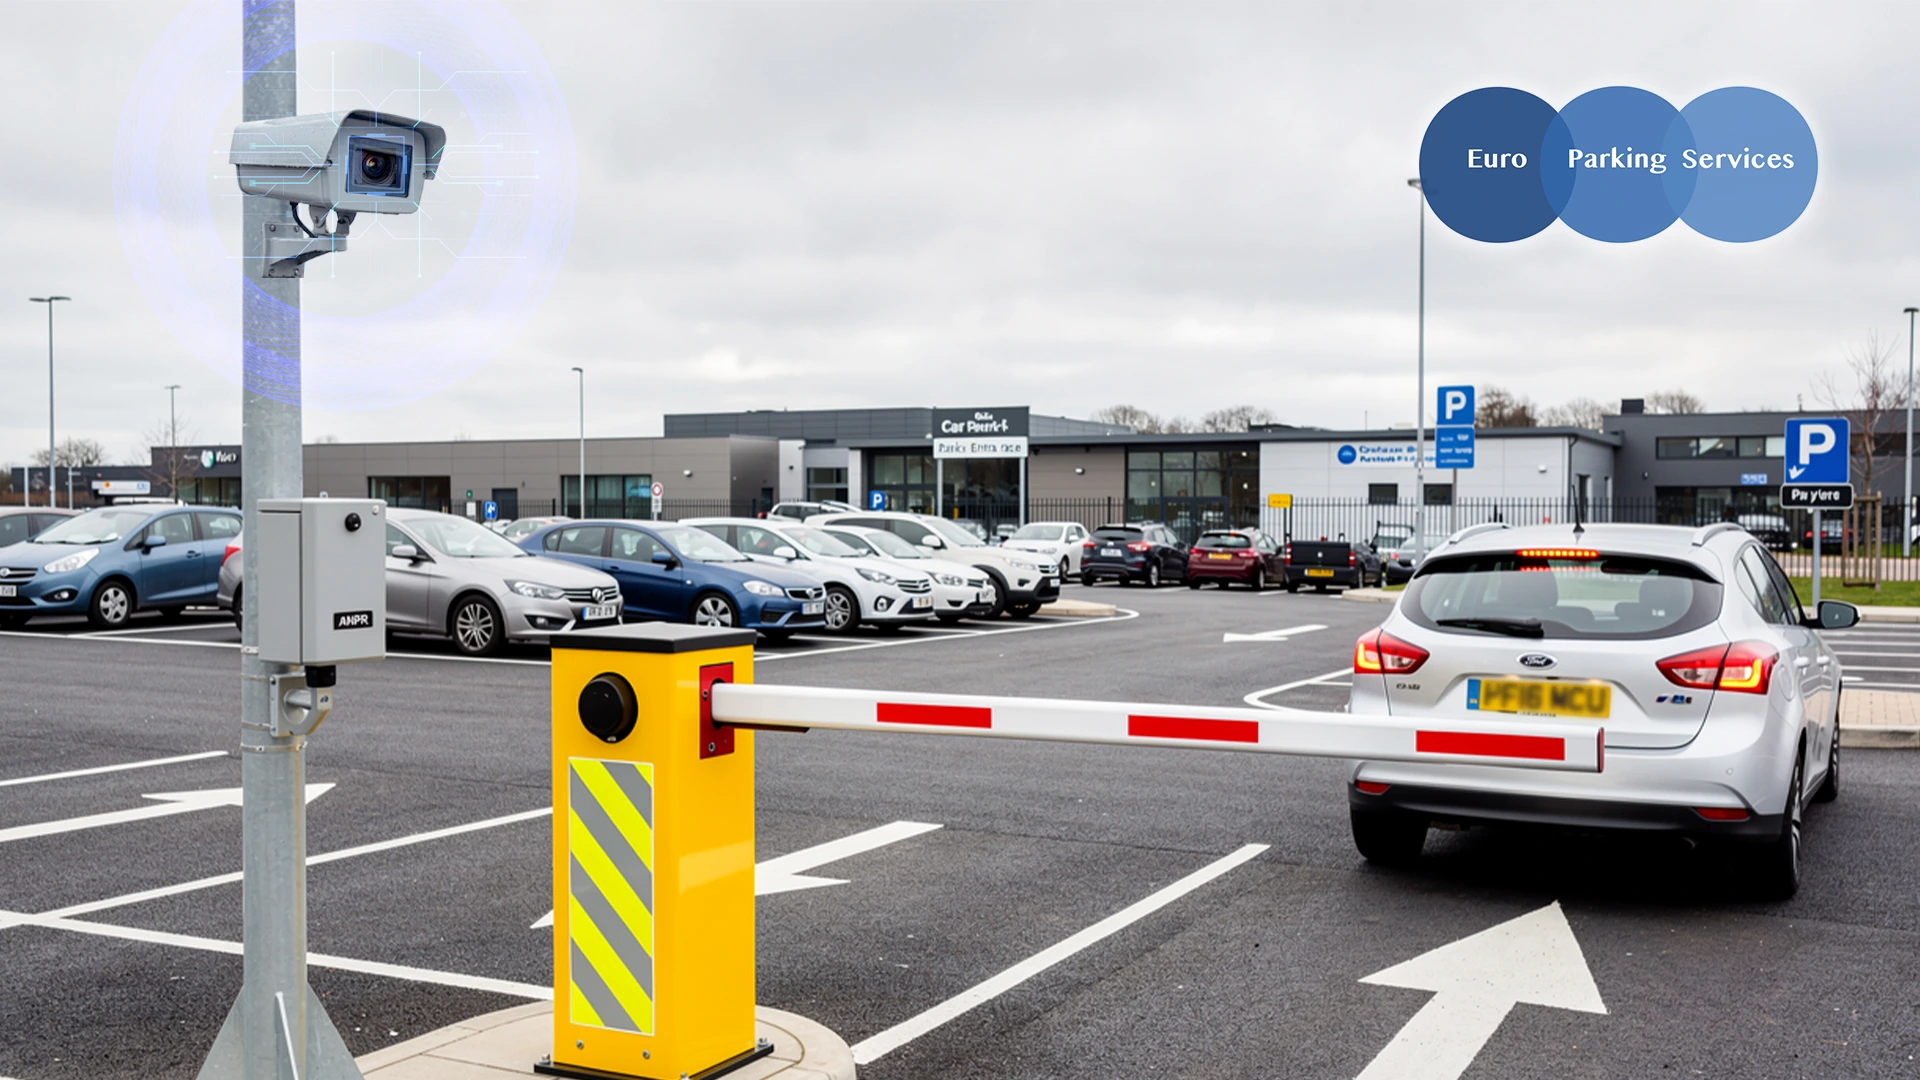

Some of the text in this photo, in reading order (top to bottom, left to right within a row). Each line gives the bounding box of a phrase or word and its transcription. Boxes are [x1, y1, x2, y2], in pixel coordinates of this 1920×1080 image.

[1445, 391, 1467, 420] P
[1799, 424, 1836, 465] P
[873, 493, 883, 508] P
[338, 614, 369, 627] ANPR
